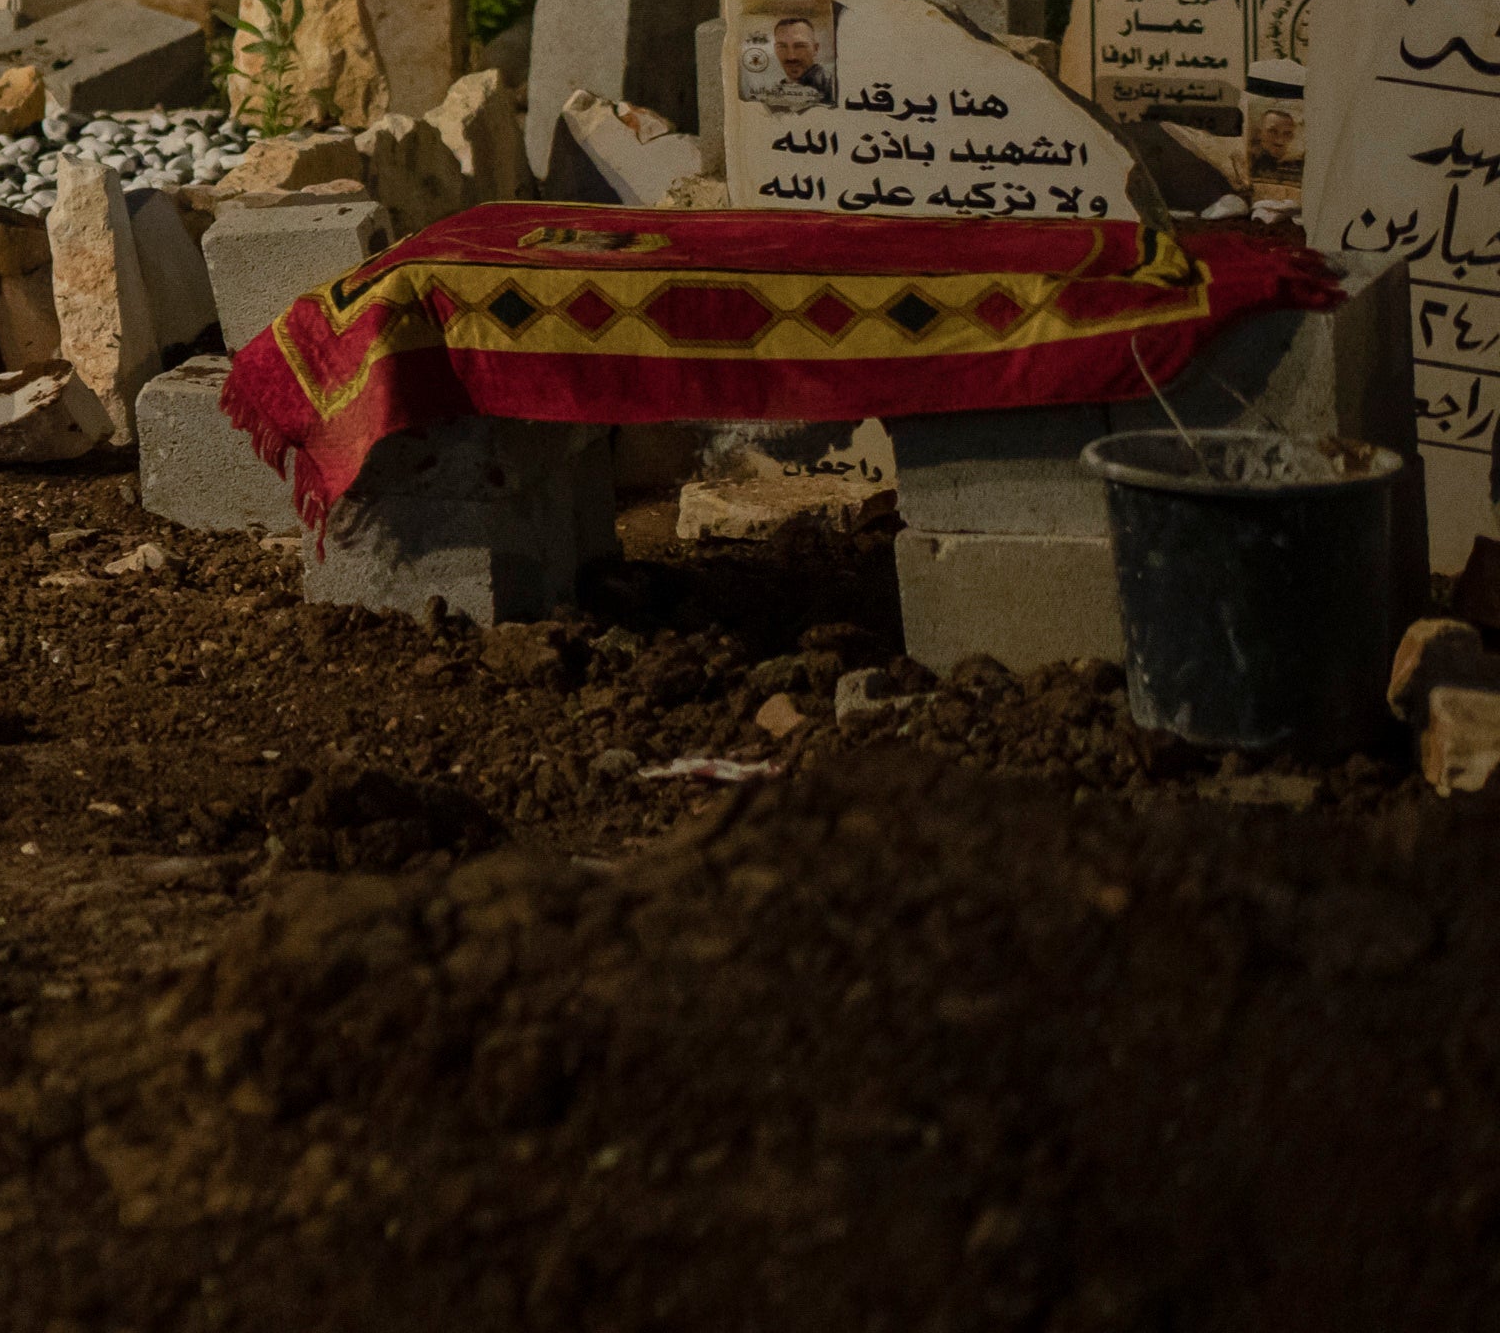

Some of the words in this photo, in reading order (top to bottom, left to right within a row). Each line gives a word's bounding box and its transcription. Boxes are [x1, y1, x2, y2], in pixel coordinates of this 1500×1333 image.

[1117, 8, 1205, 37] عمار
[1101, 44, 1143, 69] الوفا
[1146, 49, 1171, 71] ابو
[1174, 51, 1229, 69] محمد
[844, 82, 938, 123] يرقد
[949, 88, 1009, 120] هنا
[1164, 83, 1222, 102] استشهد
[771, 128, 839, 157] الله
[850, 129, 936, 167] باذن
[949, 135, 1088, 171] الشهيد
[758, 173, 826, 201] الله
[837, 177, 916, 211] على
[1049, 184, 1109, 219] ولا
